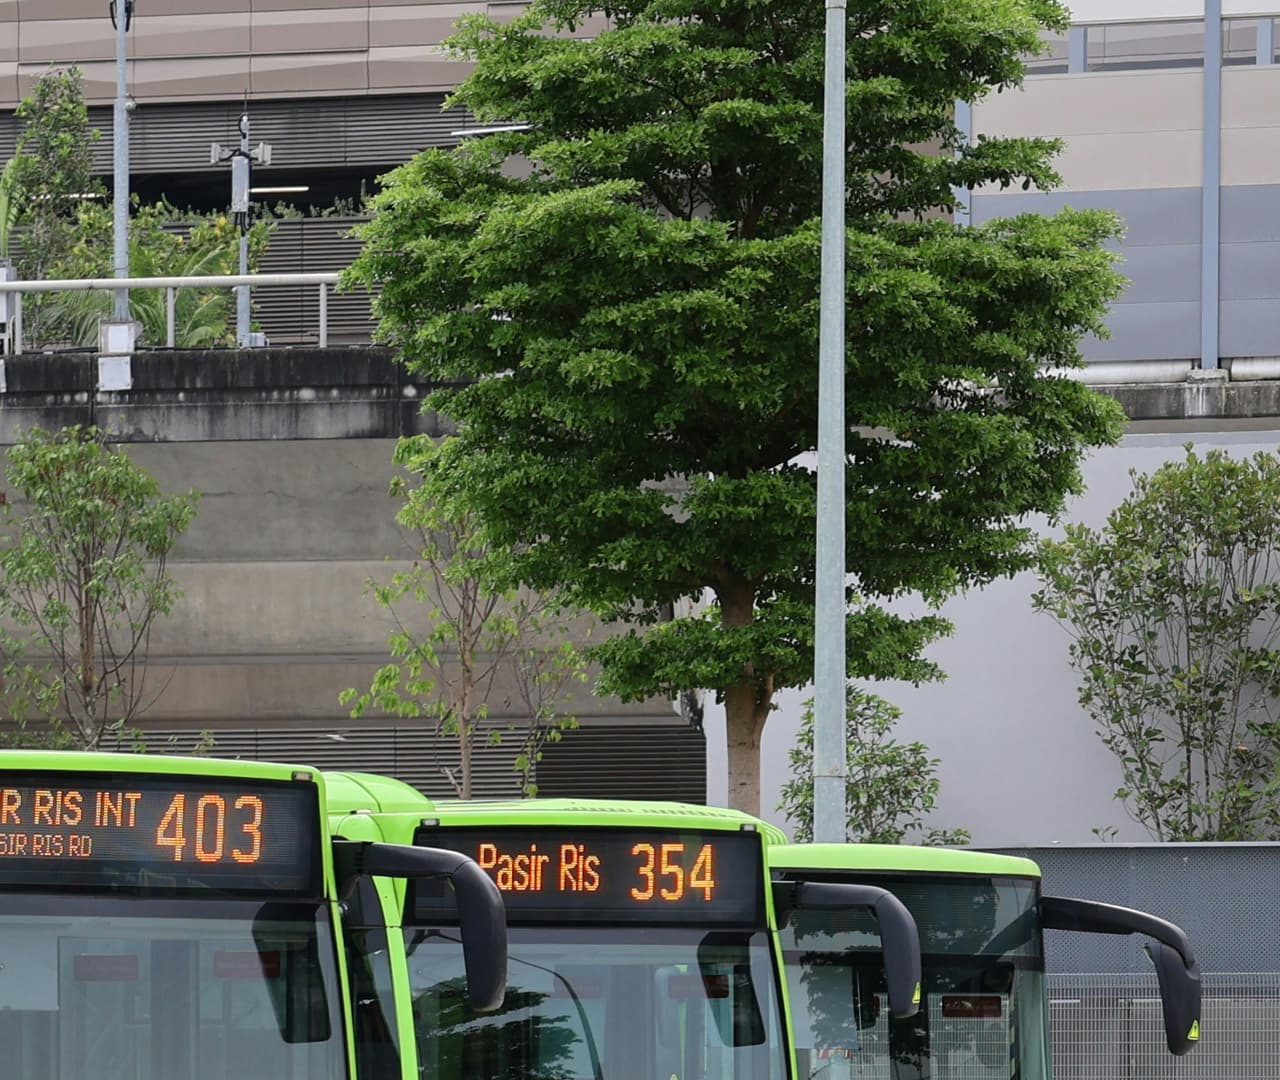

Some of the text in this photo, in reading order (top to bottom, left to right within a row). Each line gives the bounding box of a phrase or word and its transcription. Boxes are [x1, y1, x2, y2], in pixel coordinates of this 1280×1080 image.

[33, 790, 84, 826] RIS
[94, 791, 143, 827] INT
[155, 792, 264, 864] 403
[32, 833, 64, 857] RIS
[68, 834, 92, 858] RD
[479, 843, 600, 892] Pasir Ris
[630, 842, 715, 901] 354
